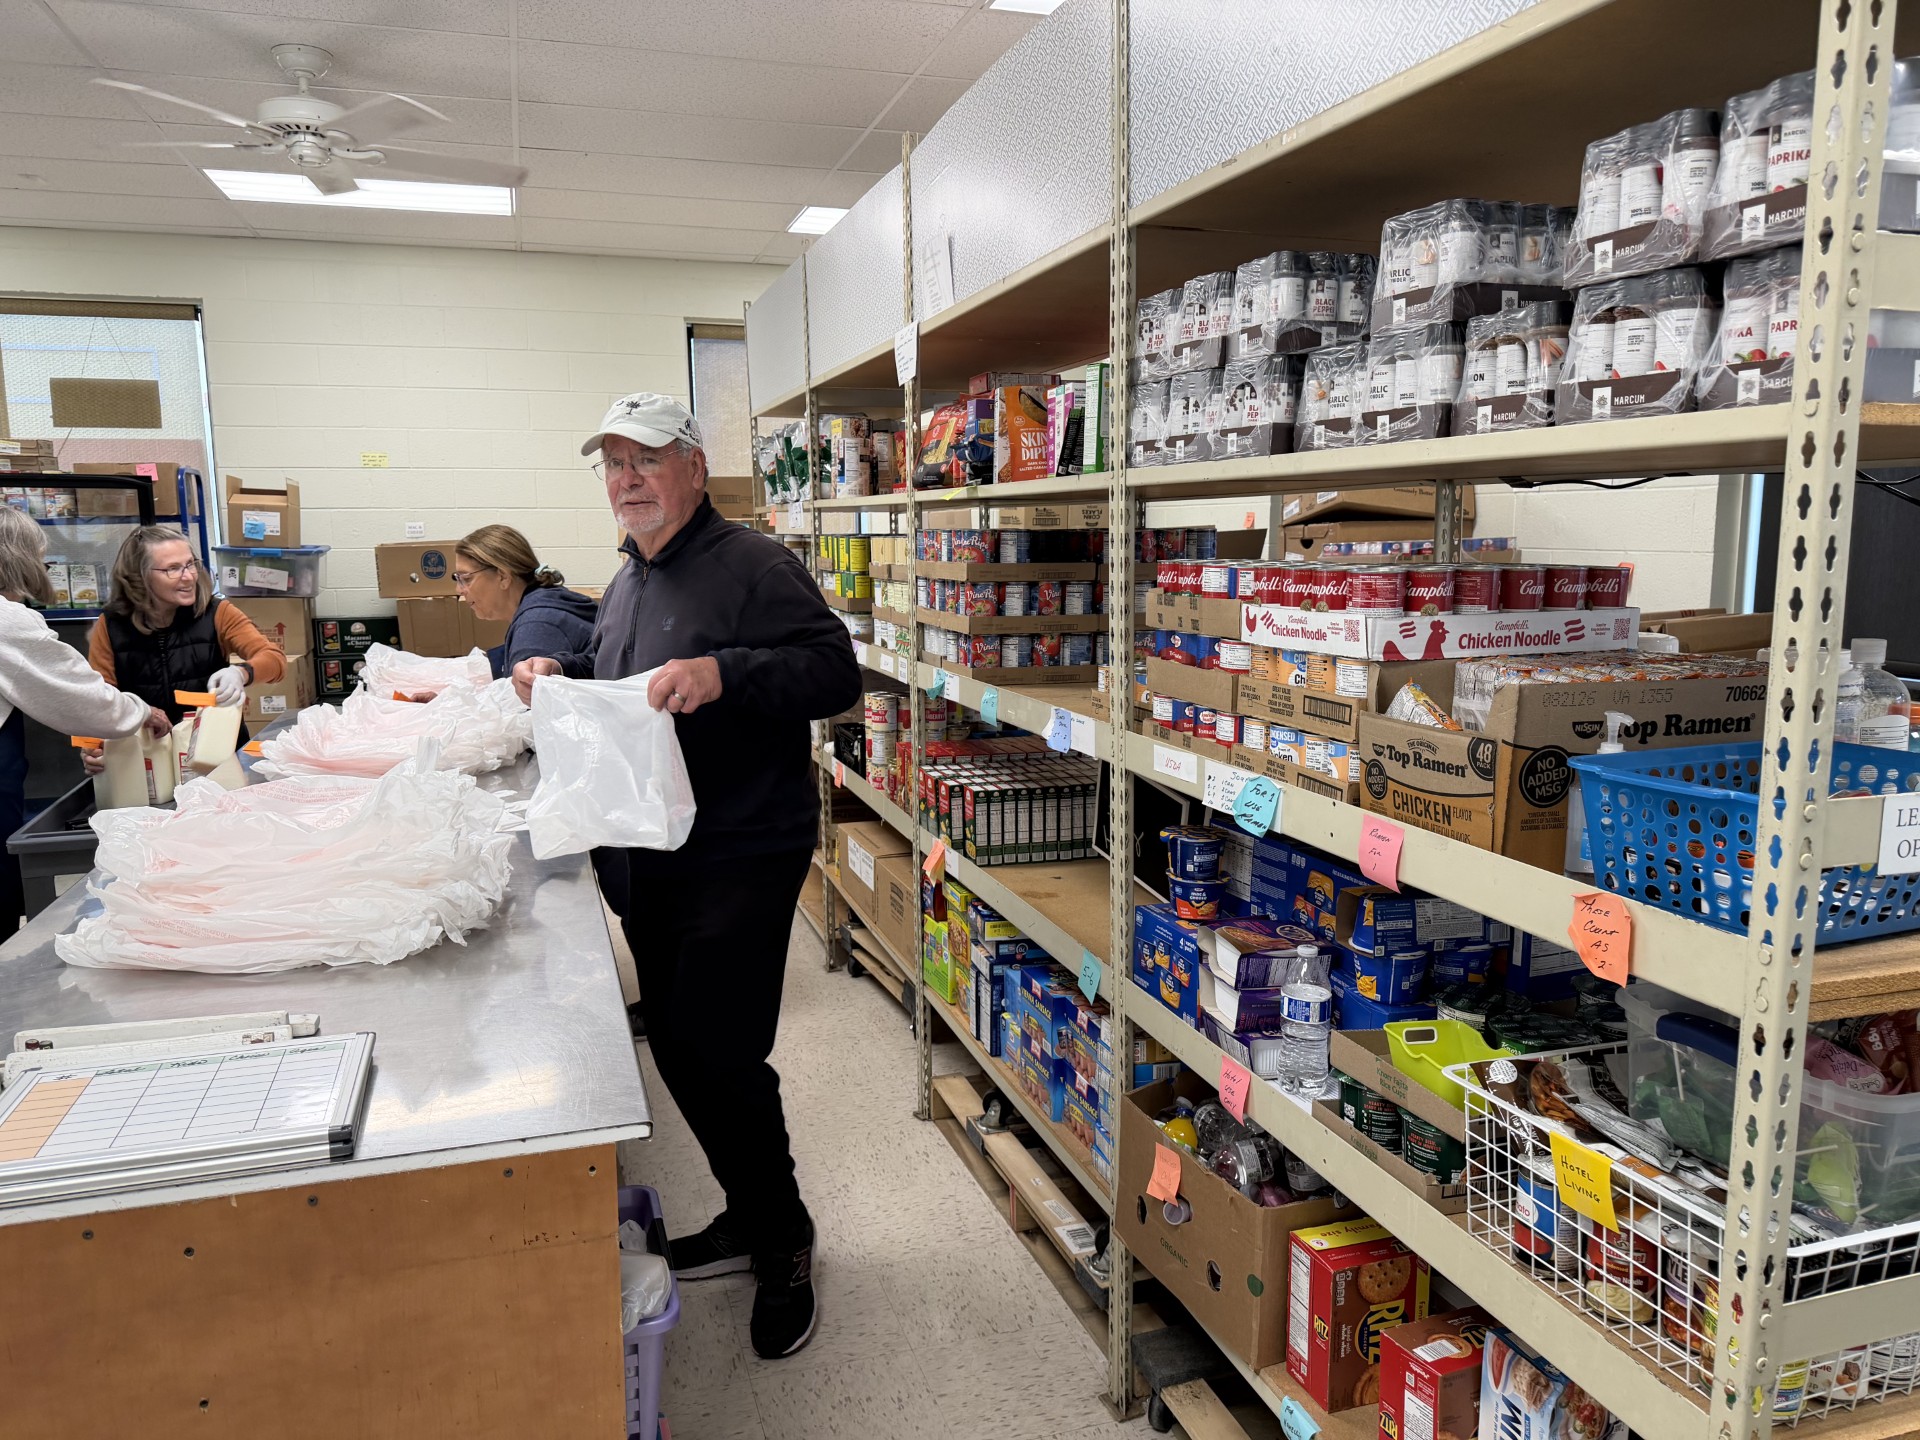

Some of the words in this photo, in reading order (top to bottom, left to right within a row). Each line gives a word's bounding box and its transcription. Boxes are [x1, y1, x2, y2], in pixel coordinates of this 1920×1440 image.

[1768, 206, 1806, 224] MARCUM
[1615, 243, 1645, 258] MARCUM
[1389, 268, 1411, 277] ARLIC
[1614, 394, 1645, 406] MARCUM
[1493, 412, 1517, 421] MARCUM
[1271, 625, 1301, 639] Chicken
[1301, 626, 1327, 641] Noodle
[1458, 632, 1512, 650] Chicken
[1513, 629, 1561, 647] Noodle
[1542, 690, 1598, 708] 082126
[1612, 690, 1631, 705] VA
[1638, 687, 1674, 704] 1355
[1574, 722, 1601, 733] NISSIN
[1662, 714, 1750, 737] Ramen
[1416, 741, 1438, 754] ORIGINAL
[1476, 742, 1492, 762] 48
[1165, 756, 1182, 770] USDA
[1386, 744, 1411, 769] Top
[1412, 751, 1466, 778] Ramen
[1476, 761, 1491, 769] PACK
[1537, 756, 1555, 773] NO
[1367, 775, 1385, 784] ADDED
[1371, 767, 1379, 776] NO
[1527, 766, 1568, 789] ADDED
[1250, 783, 1268, 798] FOR
[1392, 789, 1452, 826] CHICKEN
[1452, 806, 1472, 823] FLAVOR
[1179, 937, 1184, 945] 4
[1021, 986, 1035, 1004] VIENNA
[1035, 999, 1052, 1021] SAUSAGE
[1022, 1046, 1034, 1062] VIENNA
[1034, 1058, 1050, 1079] SAUSAGE
[1376, 1066, 1392, 1082] Knorr
[1379, 1077, 1391, 1090] Rice
[1391, 1085, 1406, 1099] Cups
[1065, 1081, 1079, 1101] VIENNA
[1079, 1096, 1098, 1118] SAUSAGE
[1561, 1154, 1594, 1183] HOTEL
[1563, 1173, 1601, 1204] LIVING
[1320, 1228, 1342, 1237] size
[1160, 1237, 1189, 1268] ORGANIC
[1622, 1276, 1644, 1286] Nodle
[1313, 1315, 1329, 1340] RITZ
[1380, 1412, 1398, 1440] RITZ
